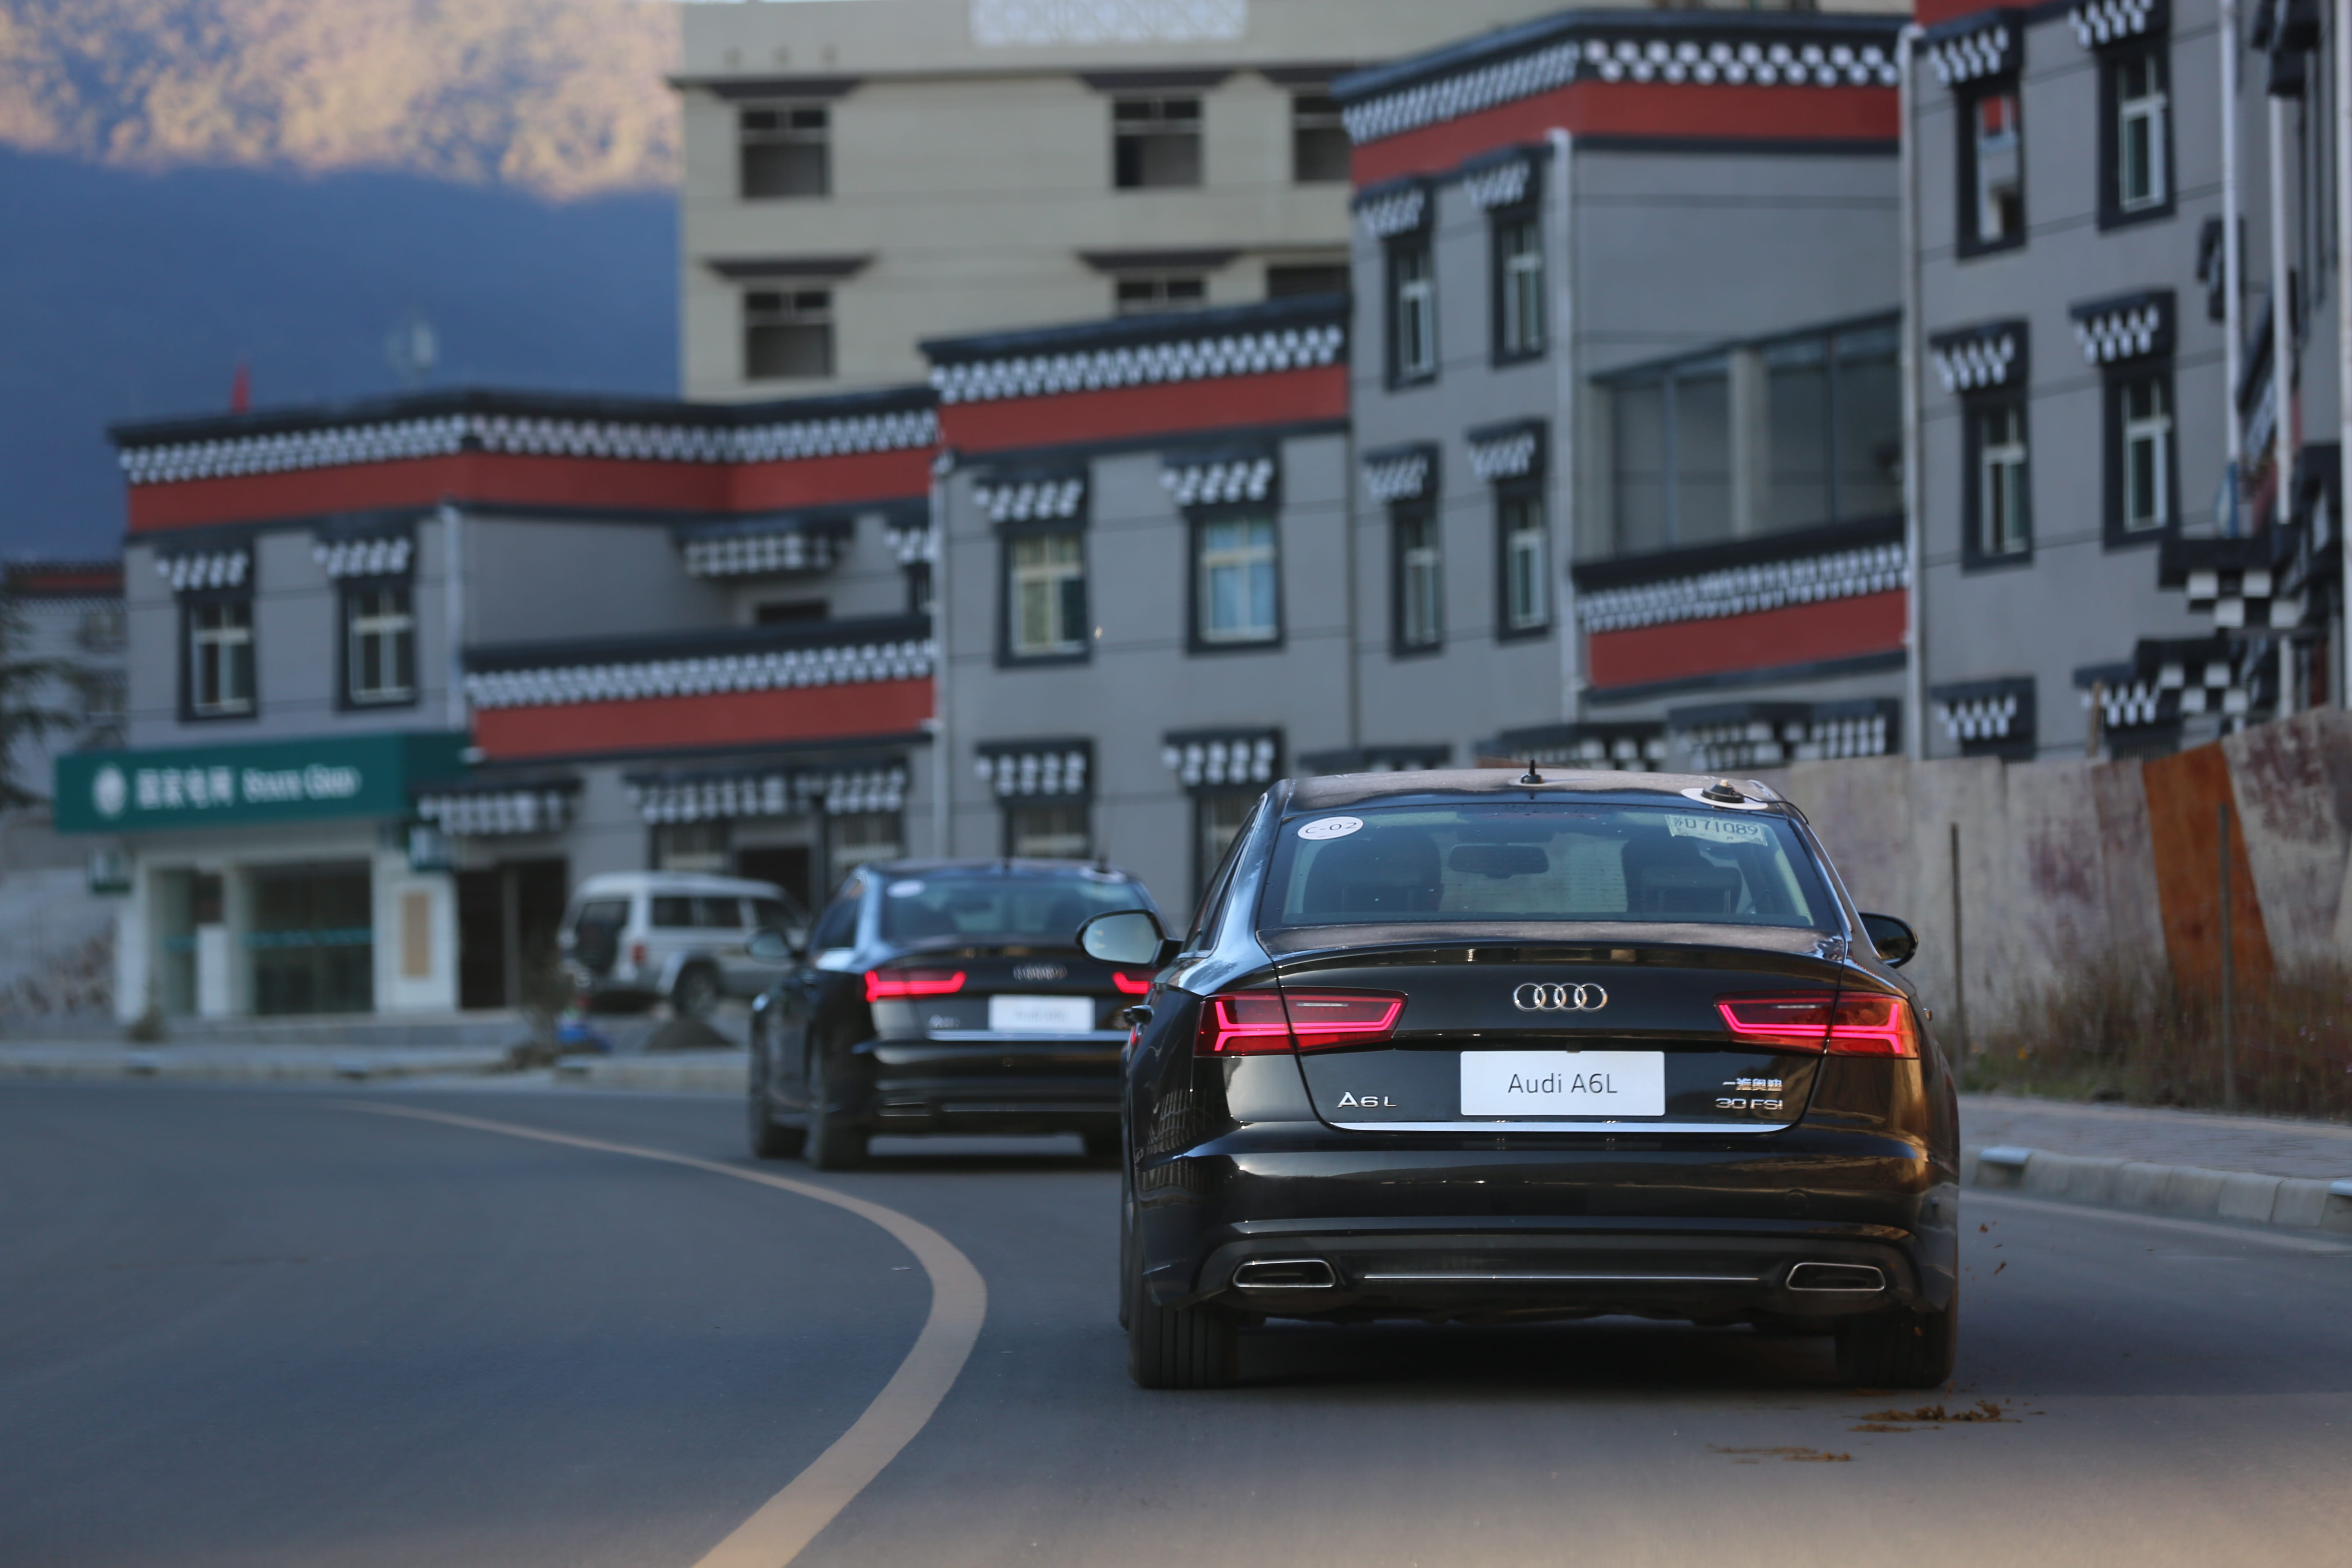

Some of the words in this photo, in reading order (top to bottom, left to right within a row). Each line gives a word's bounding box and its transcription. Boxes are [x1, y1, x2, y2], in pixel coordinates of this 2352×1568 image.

[1305, 822, 1356, 834] C-02
[1508, 1073, 1561, 1093] Audi
[1570, 1073, 1618, 1093] A6L
[1722, 1078, 1782, 1091] 一汽奥迪
[1715, 1098, 1746, 1109] 30
[1750, 1099, 1783, 1110] FSI
